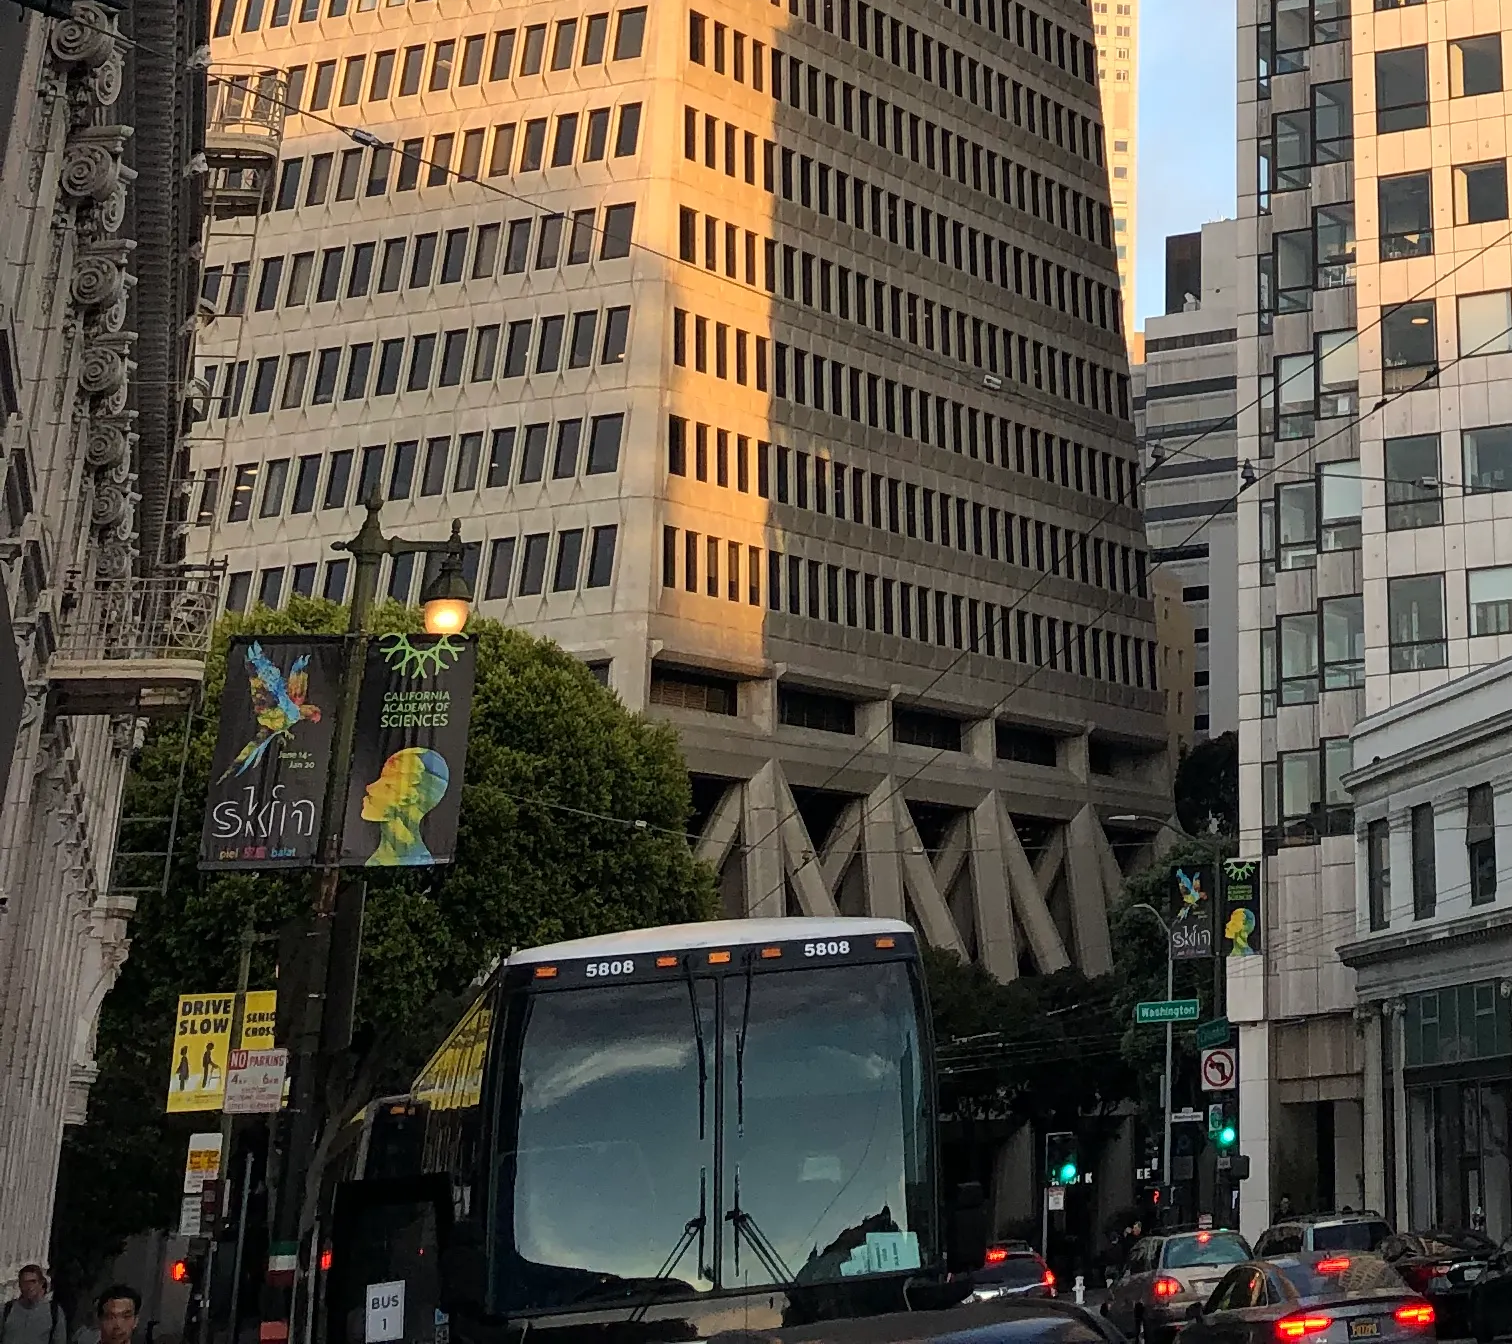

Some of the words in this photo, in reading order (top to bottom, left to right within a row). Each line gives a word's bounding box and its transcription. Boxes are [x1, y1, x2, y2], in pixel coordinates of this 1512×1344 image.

[383, 690, 451, 703] CALIFORNIA
[382, 702, 433, 713] ACADEMY
[435, 701, 450, 712] OF
[380, 713, 449, 728] SCIENCES
[289, 760, 303, 769] Jan
[304, 761, 315, 769] 20
[212, 784, 315, 838] skin
[218, 847, 240, 861] piel
[1172, 924, 1211, 948] skin
[804, 940, 850, 957] 5808
[585, 960, 634, 978] 5808
[181, 999, 232, 1017] DRIVE
[1141, 1005, 1195, 1018] Washington
[178, 1018, 229, 1036] SLOW
[229, 1051, 247, 1069] NO
[249, 1055, 285, 1067] PARKING
[371, 1294, 399, 1310] BUS
[382, 1318, 387, 1331] 1
